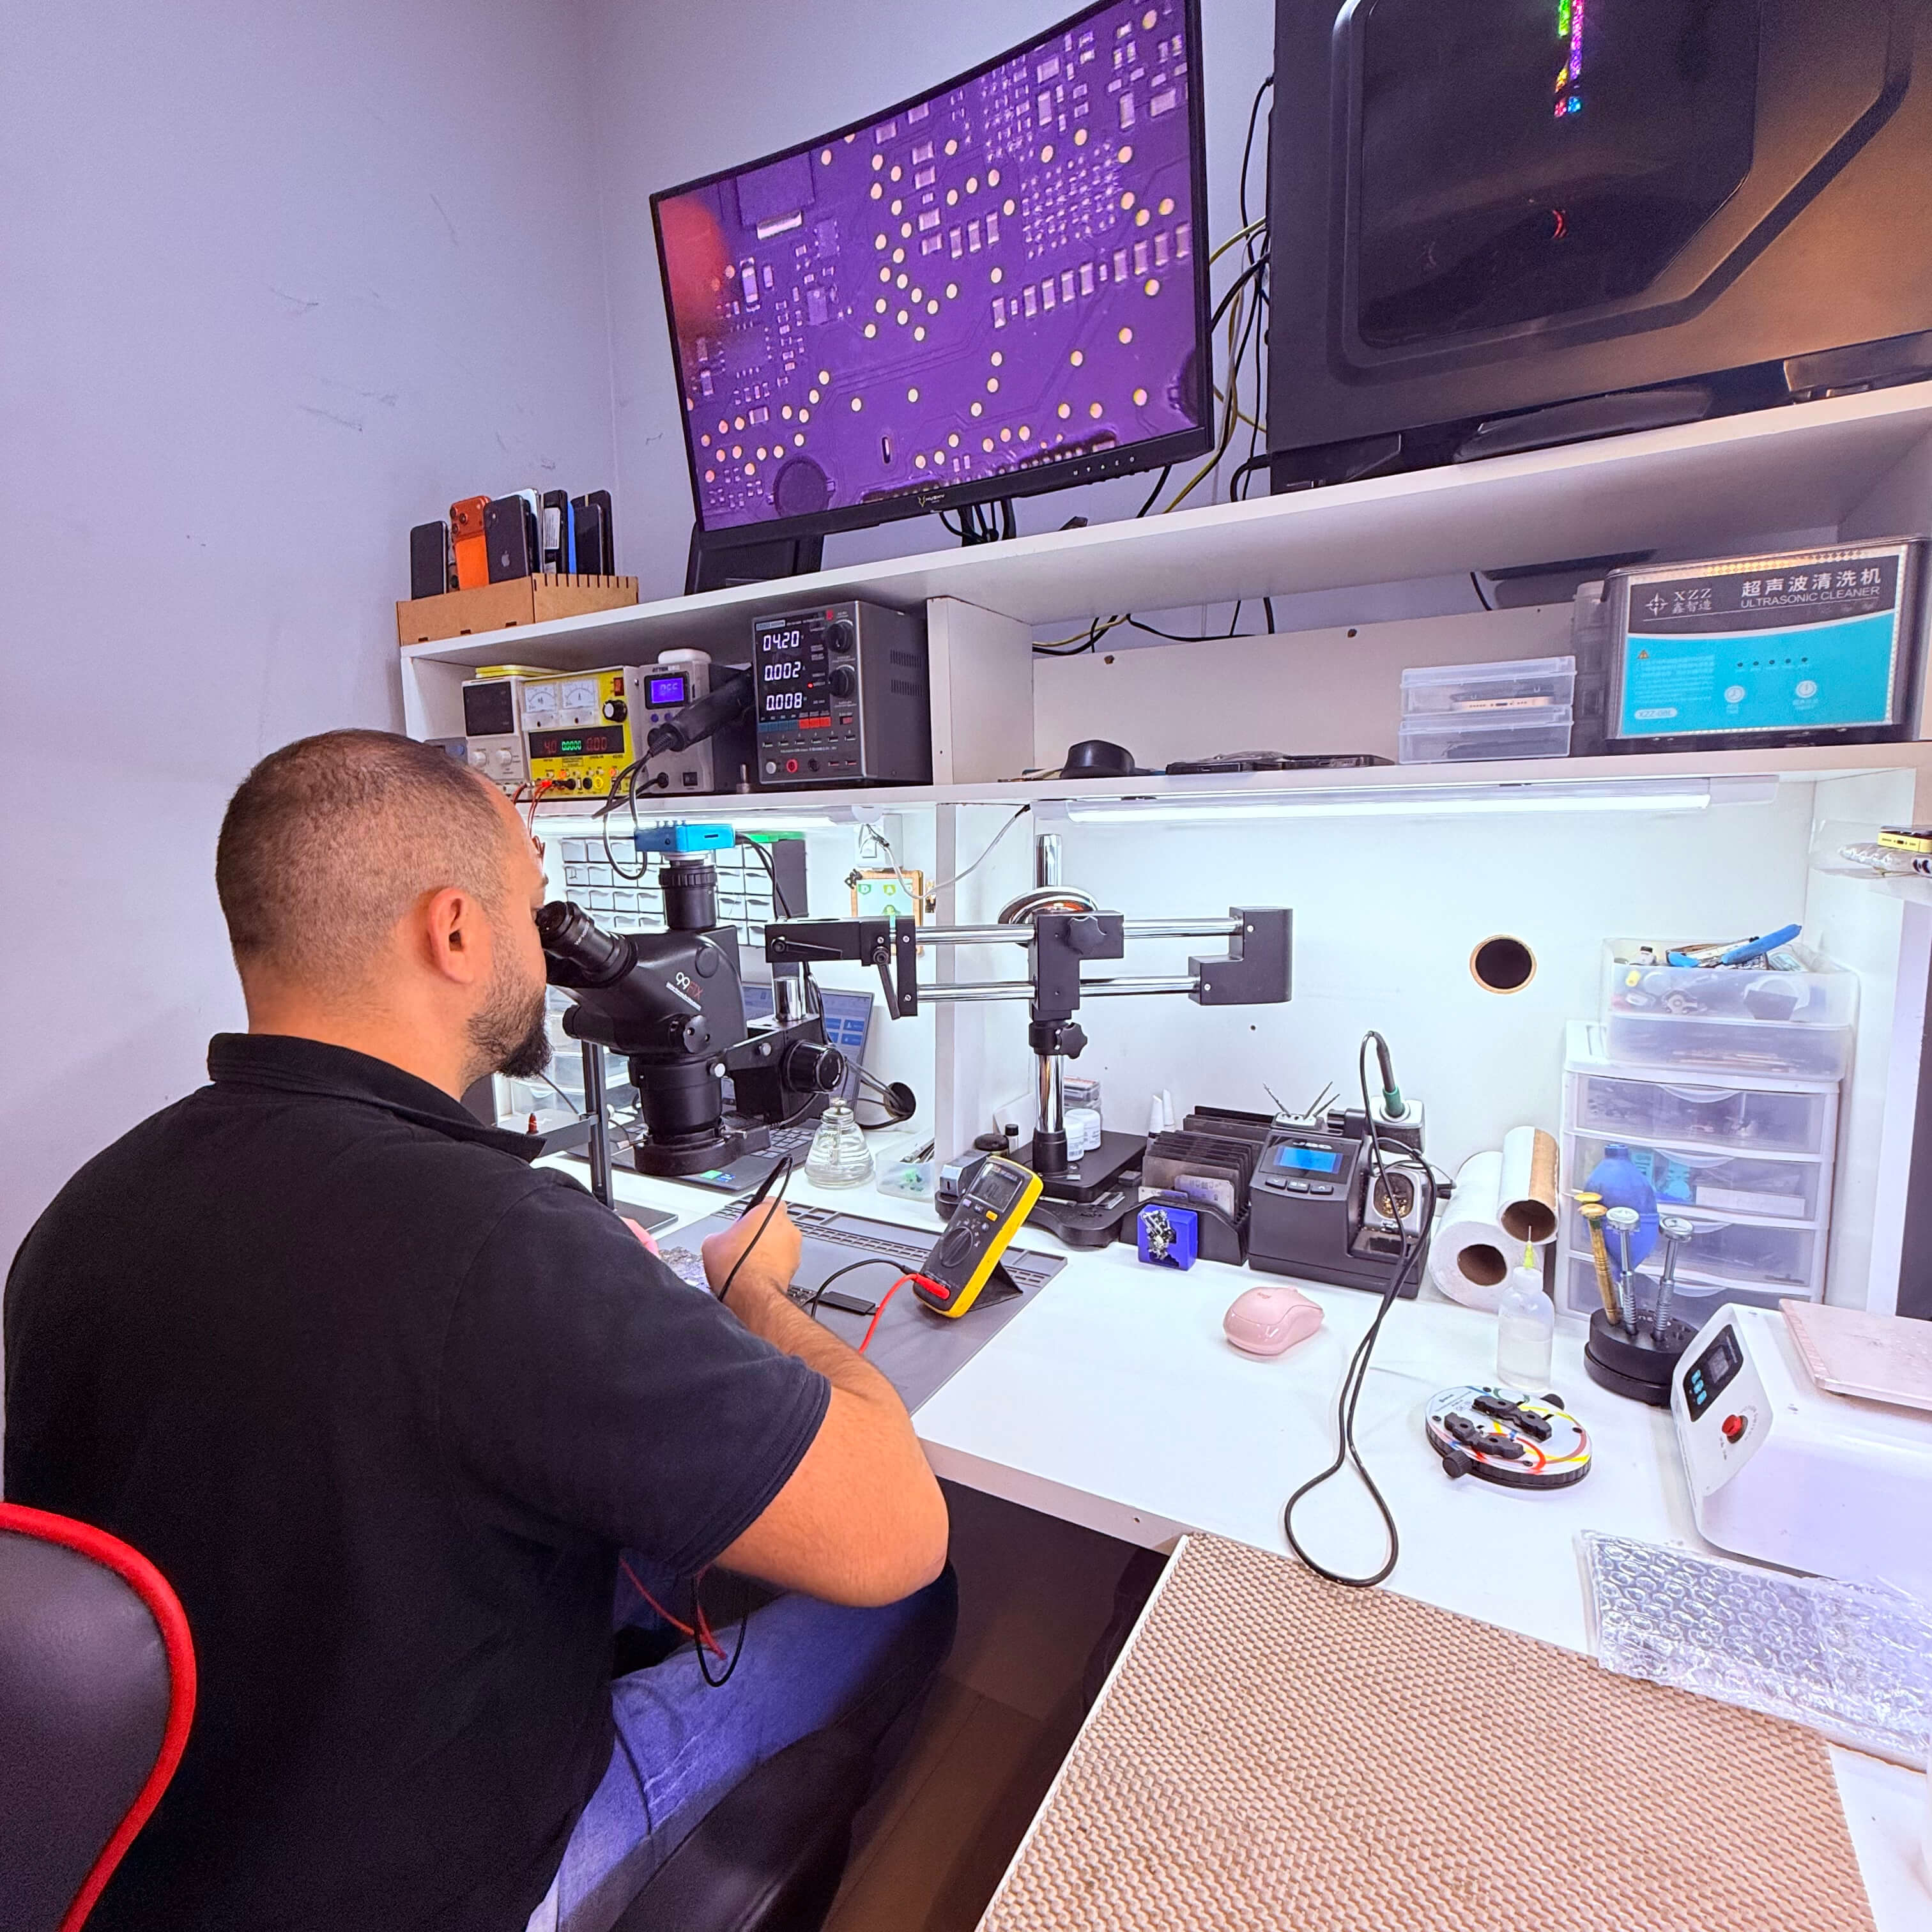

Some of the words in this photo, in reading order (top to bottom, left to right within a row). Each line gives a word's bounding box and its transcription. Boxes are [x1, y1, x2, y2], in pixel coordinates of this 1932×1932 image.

[1742, 567, 1882, 597] 超声波清洗机
[1674, 588, 1712, 601] XZZ
[1740, 592, 1818, 608] ULTRASONIC
[1820, 586, 1880, 601] CLEANER
